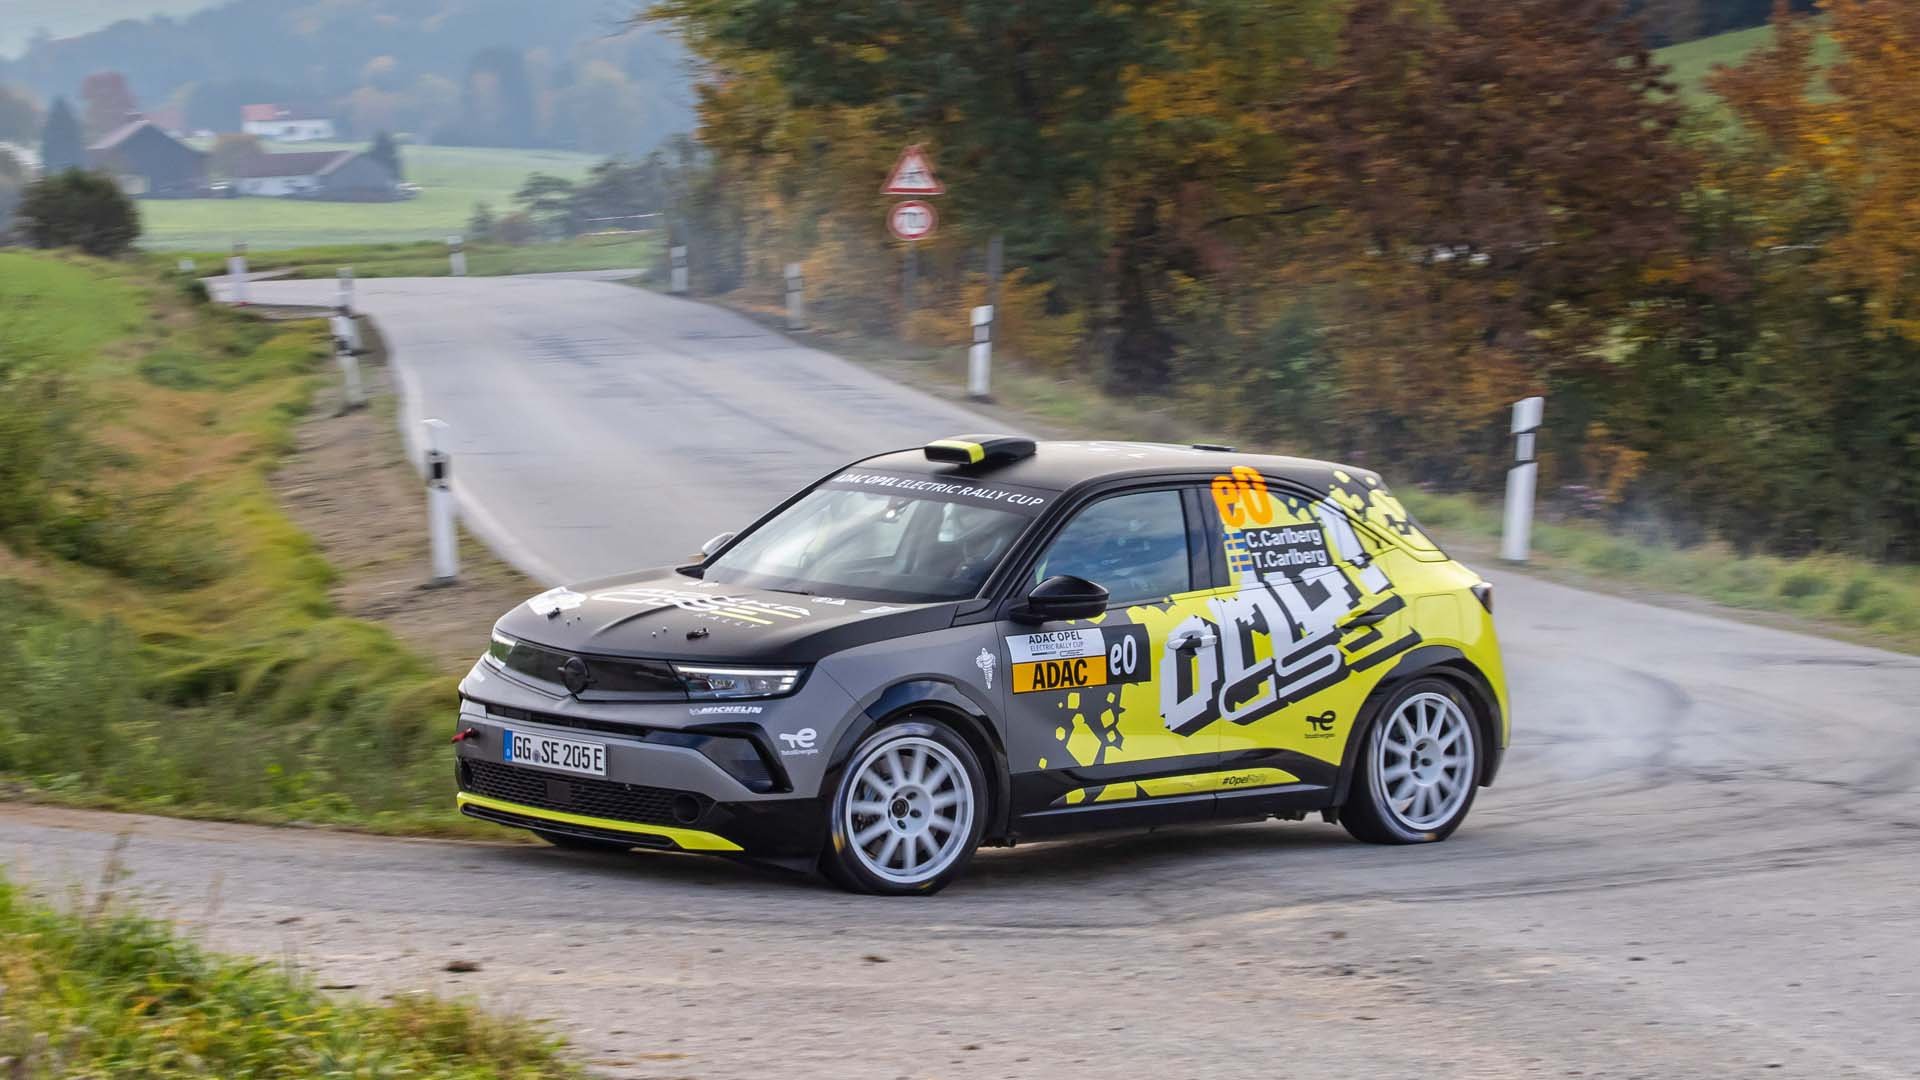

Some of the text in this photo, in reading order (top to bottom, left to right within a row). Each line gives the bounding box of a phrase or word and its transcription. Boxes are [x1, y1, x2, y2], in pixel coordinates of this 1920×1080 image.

[864, 475, 899, 487] OPEL
[897, 479, 961, 494] ELECTRIC
[958, 486, 1008, 501] RALLY
[1007, 494, 1044, 507] CUP
[1245, 527, 1322, 549] C.Carlberg
[1252, 547, 1328, 569] T.Carlberg
[1029, 631, 1083, 644] ADAC OPEL
[1032, 659, 1088, 690] ADAC
[700, 705, 763, 714] MICHELIN
[513, 735, 603, 772] GG SE 205 E
